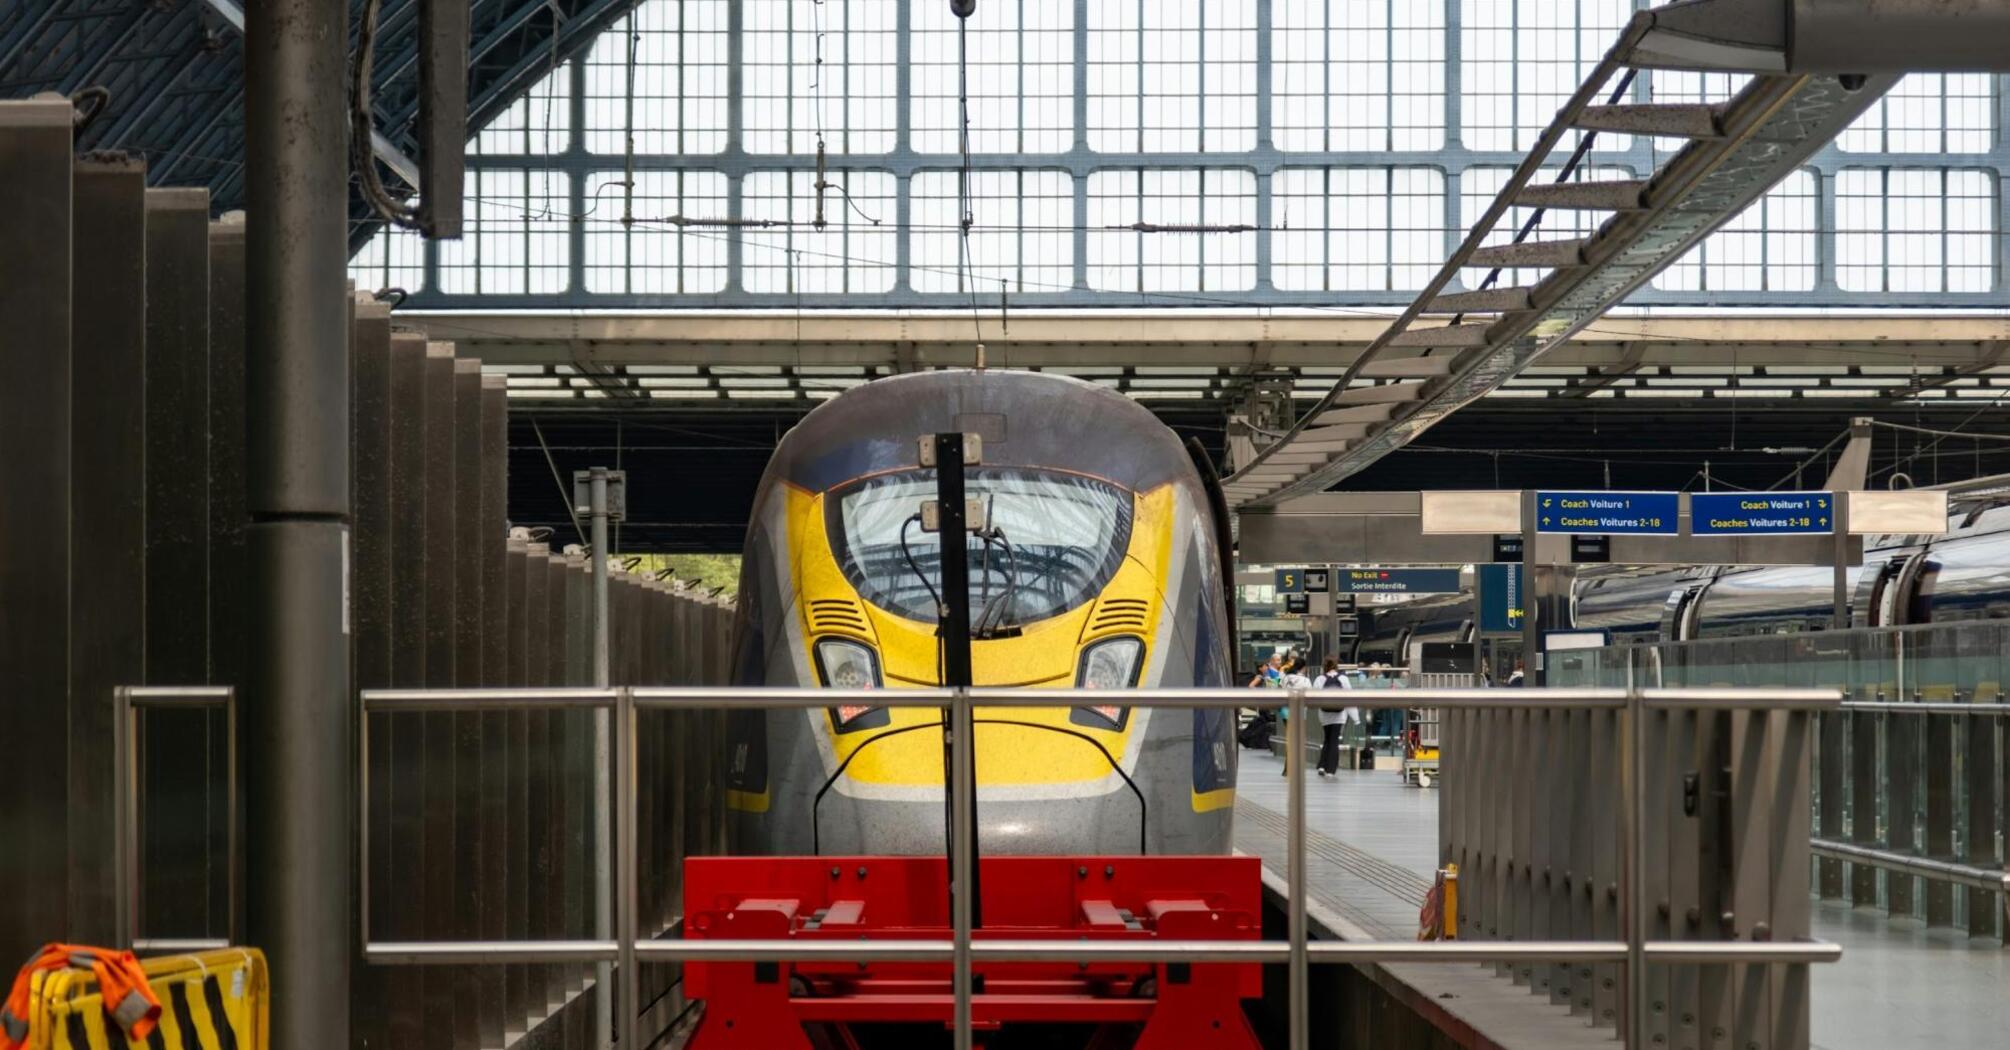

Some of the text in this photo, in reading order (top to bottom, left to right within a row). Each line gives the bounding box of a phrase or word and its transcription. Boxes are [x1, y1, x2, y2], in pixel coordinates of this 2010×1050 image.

[1560, 499, 1630, 509] Coach Voiture 1
[1740, 500, 1810, 510] Coach Voiture 1
[1560, 517, 1661, 527] Coaches Voitures 2-18
[1710, 517, 1810, 528] Coaches Voitures 2-18
[1351, 571, 1378, 580] No Exit
[1284, 575, 1294, 588] 5
[1351, 582, 1407, 590] Sortie Interdite
